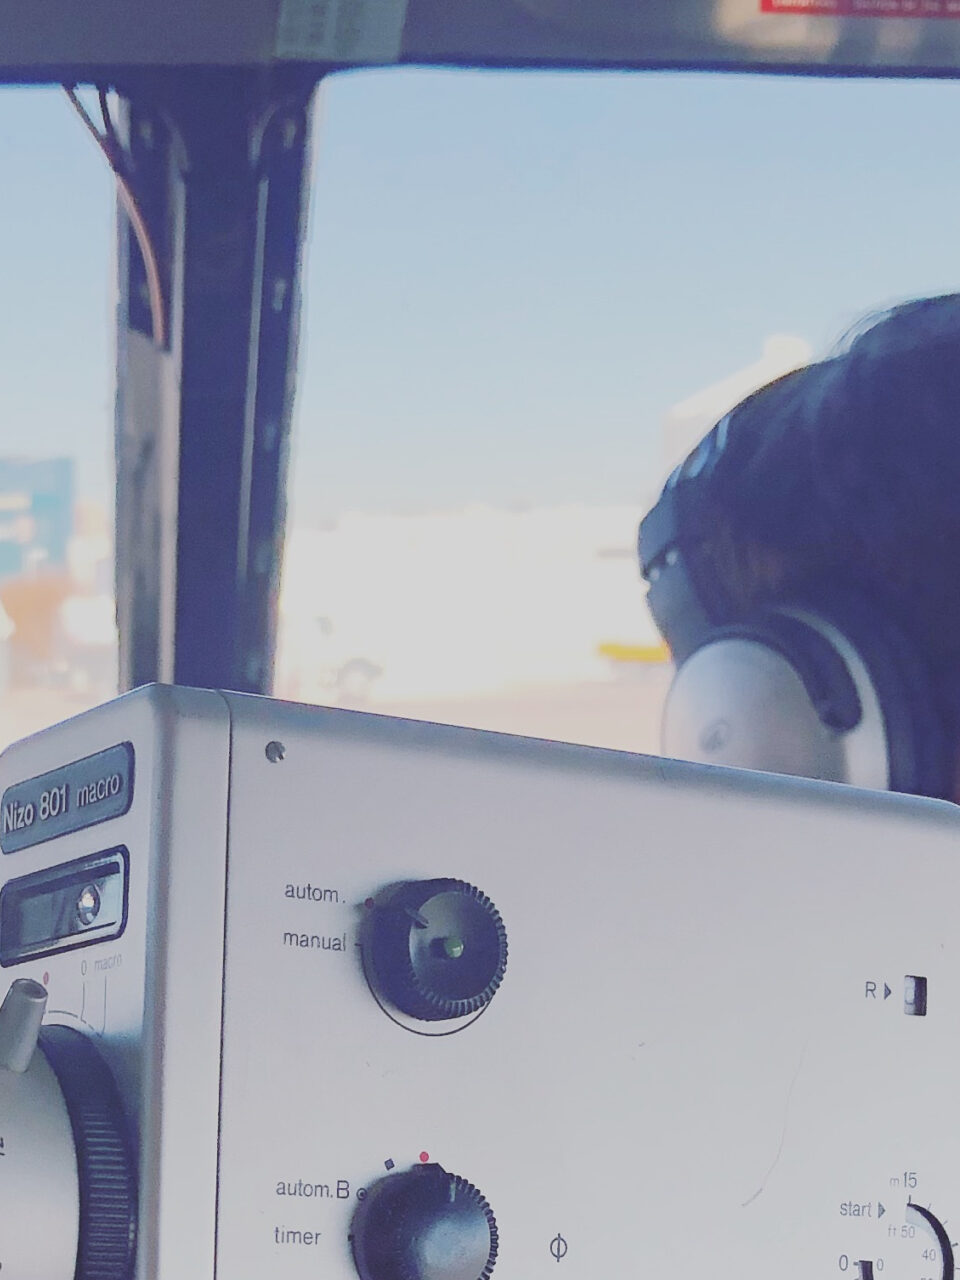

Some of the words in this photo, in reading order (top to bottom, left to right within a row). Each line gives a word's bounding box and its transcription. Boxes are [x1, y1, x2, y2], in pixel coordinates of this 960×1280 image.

[3, 803, 34, 834] Nizo
[40, 784, 70, 820] 801
[76, 773, 121, 807] macro
[284, 883, 347, 904] autom.
[283, 930, 347, 952] manual
[865, 981, 877, 999] R
[903, 1171, 918, 1189] 15
[839, 1200, 872, 1218] start
[274, 1226, 322, 1247] timer
[901, 1225, 916, 1239] 50
[838, 1254, 849, 1271] 0
[922, 1248, 937, 1262] 40
[876, 1258, 884, 1271] 0
